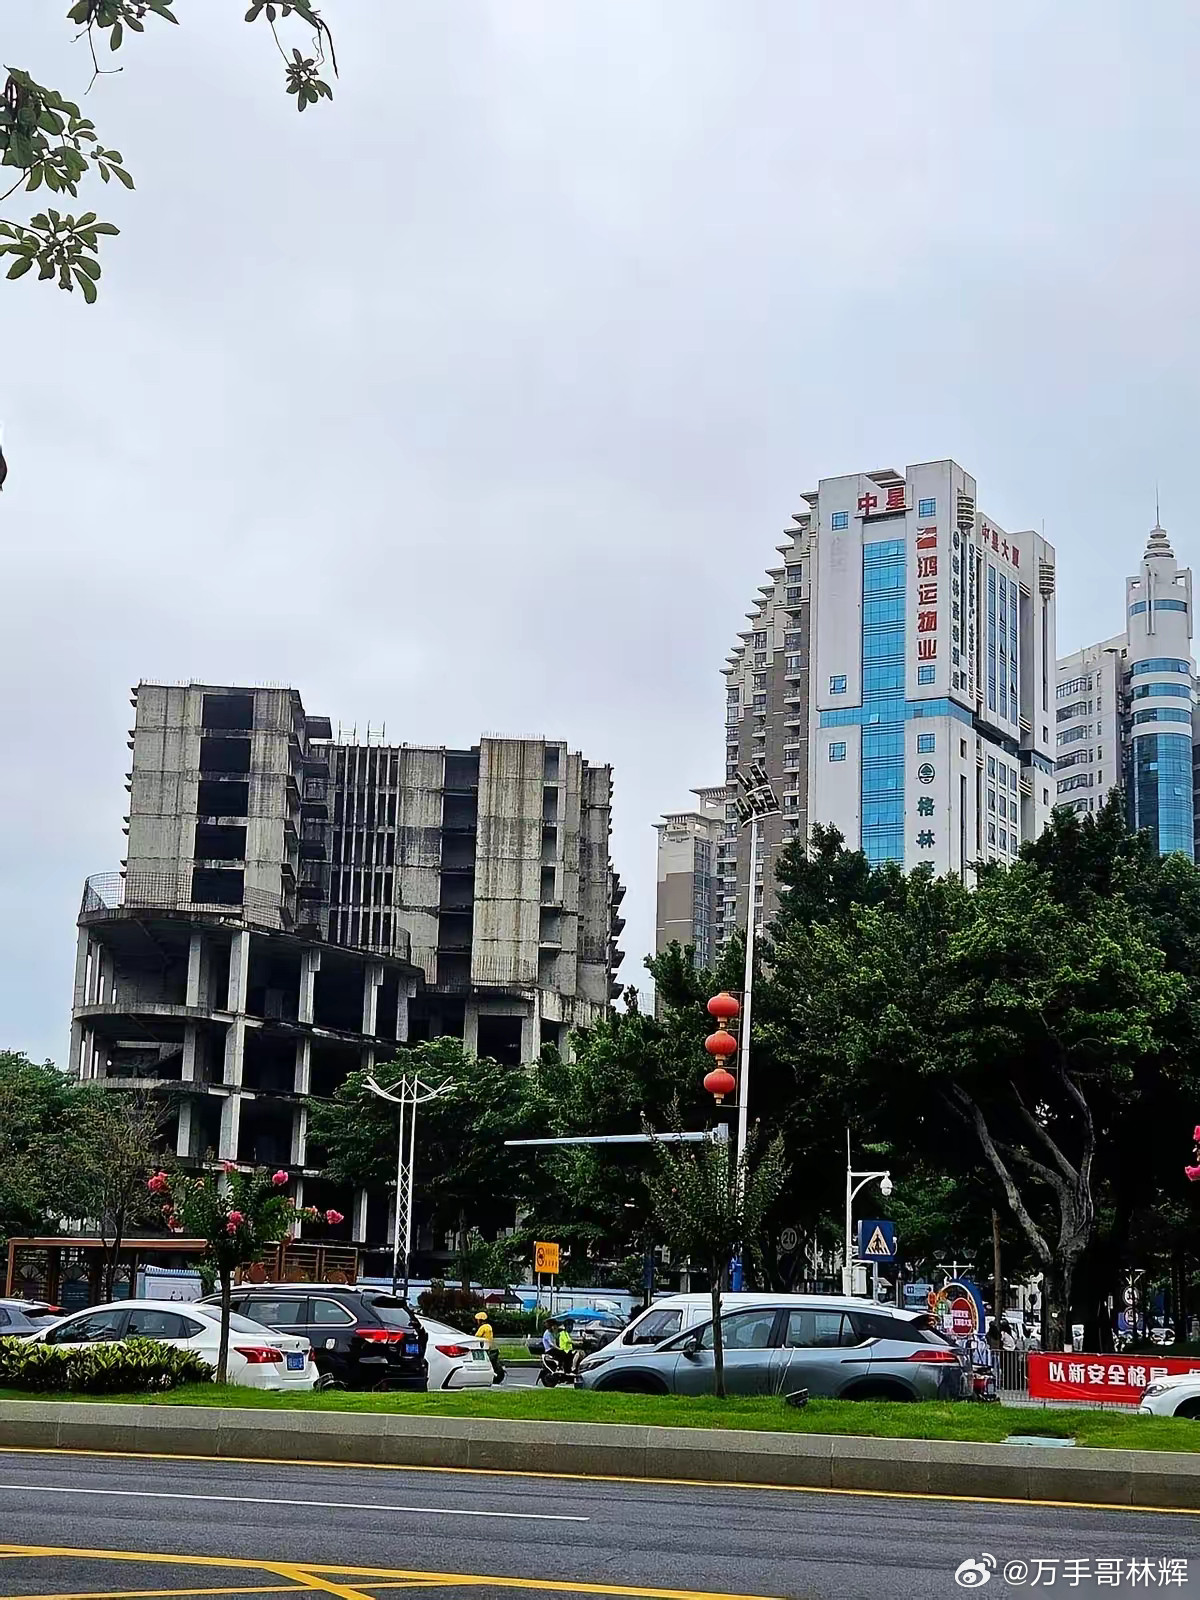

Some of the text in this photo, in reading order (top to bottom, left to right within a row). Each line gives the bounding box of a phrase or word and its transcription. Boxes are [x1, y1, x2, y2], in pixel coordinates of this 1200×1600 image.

[858, 486, 906, 516] 中星
[918, 555, 937, 661] 鸿运物业
